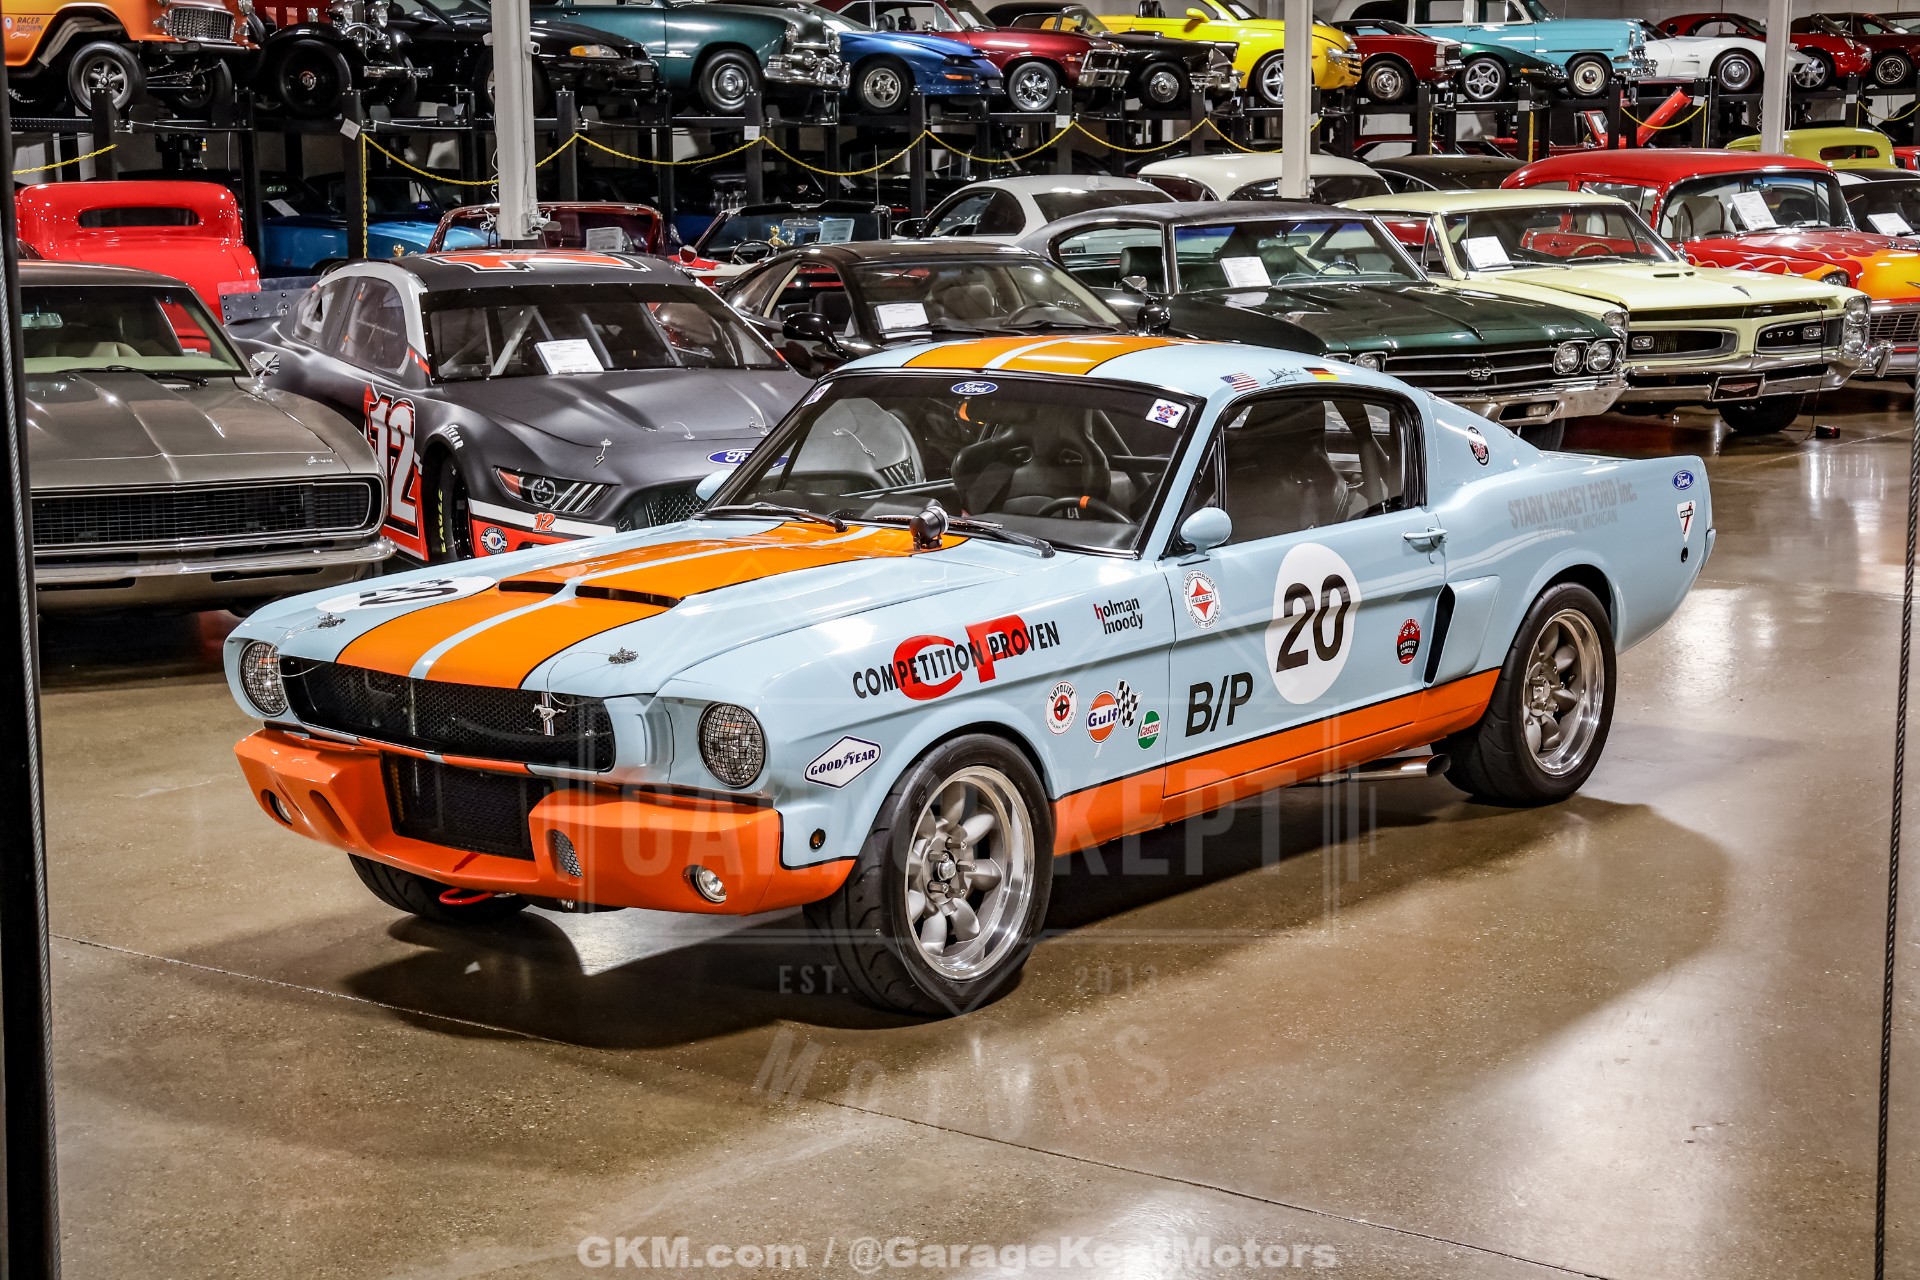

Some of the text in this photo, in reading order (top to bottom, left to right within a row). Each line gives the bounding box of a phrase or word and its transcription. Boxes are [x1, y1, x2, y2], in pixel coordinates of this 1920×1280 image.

[1766, 330, 1794, 339] GTO
[1469, 368, 1491, 378] SS
[955, 381, 994, 394] Ford
[366, 396, 419, 530] 12
[1675, 471, 1692, 488] Ford
[1507, 494, 1548, 530] STARK
[1545, 484, 1588, 521] HICKEY
[1587, 478, 1618, 511] FORD
[533, 512, 556, 532] 12
[1094, 598, 1141, 621] holman
[1104, 611, 1144, 635] moody
[1276, 574, 1351, 673] 20
[852, 620, 1061, 699] COMPETITION PROVEN
[1050, 684, 1075, 702] AUTOLITE
[1185, 671, 1254, 738] B/P
[1088, 707, 1118, 728] Gulf
[1140, 721, 1161, 737] Castrol
